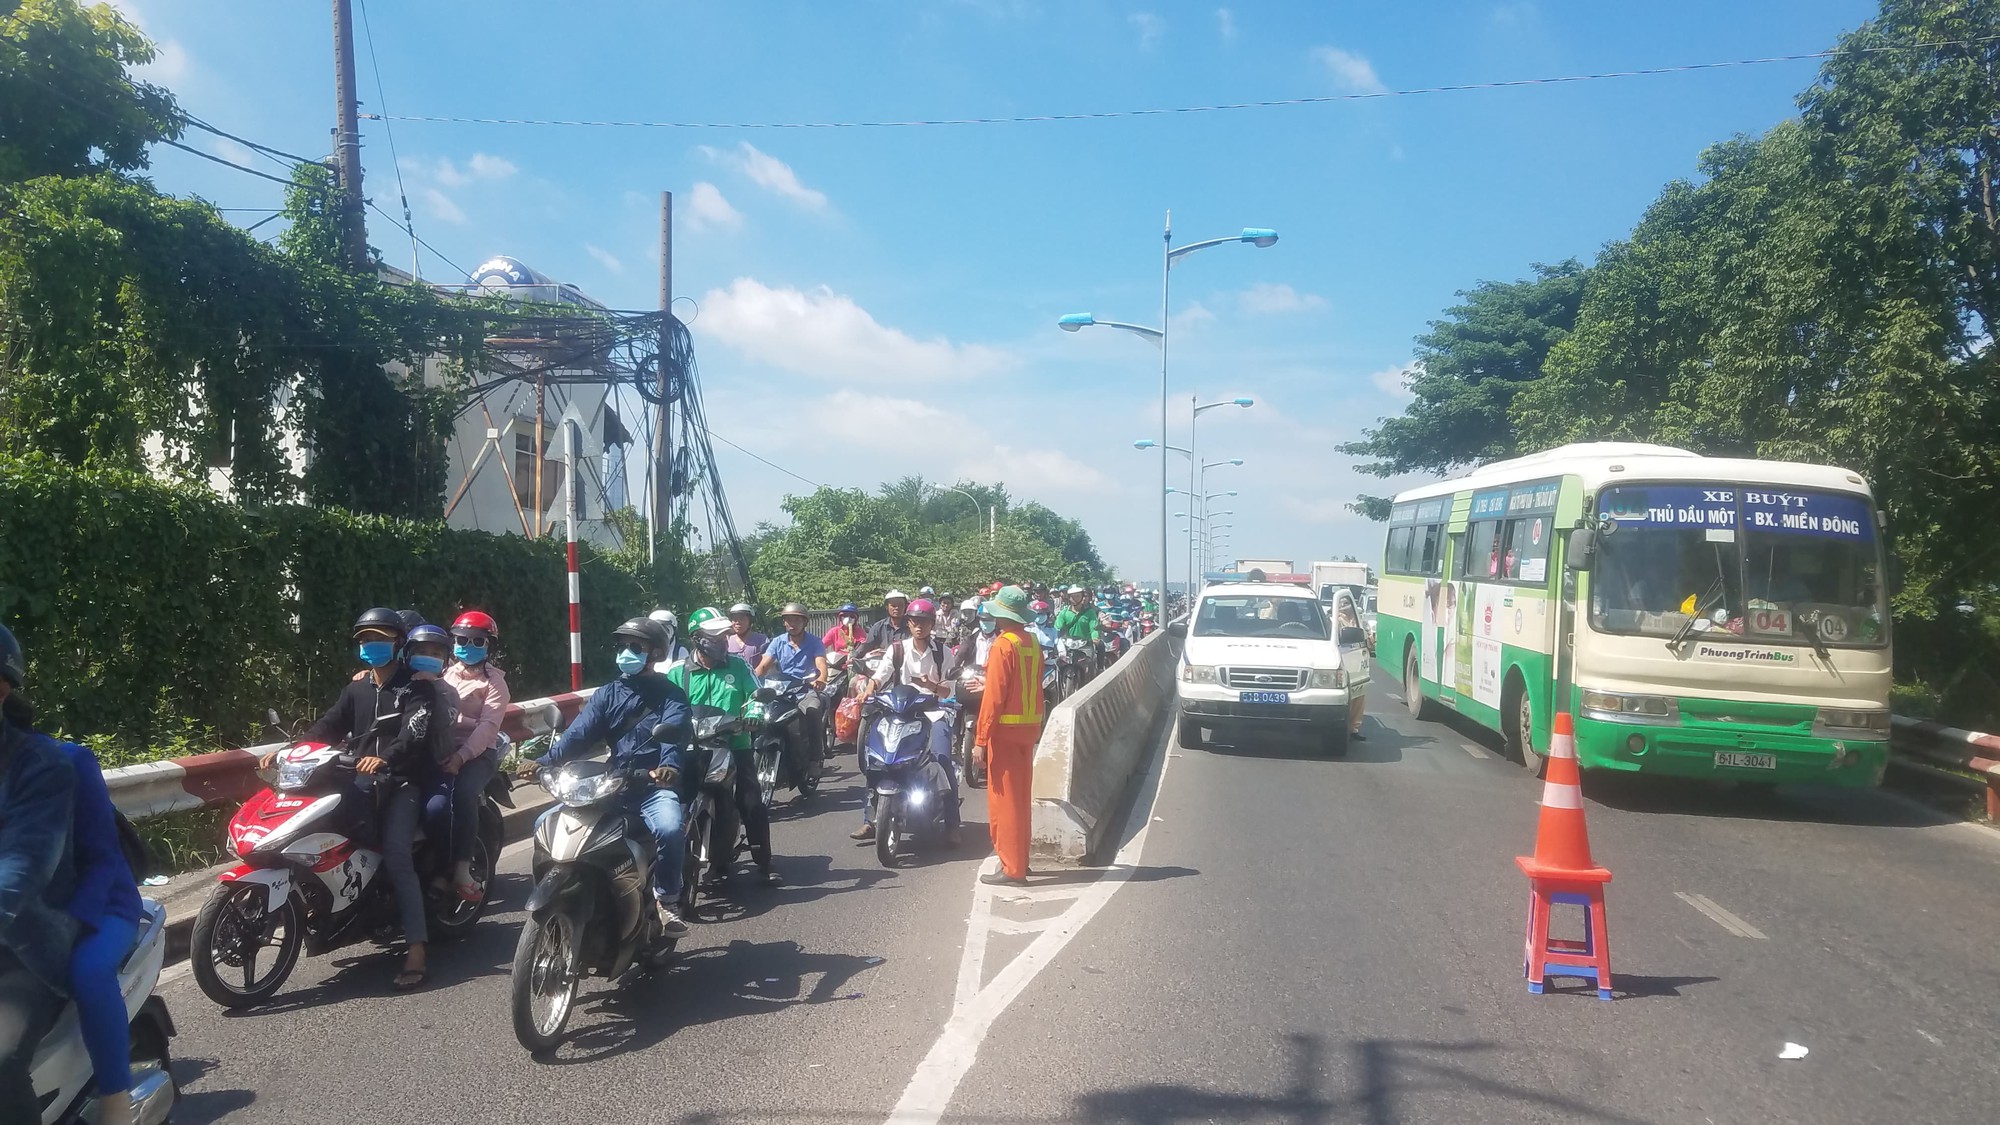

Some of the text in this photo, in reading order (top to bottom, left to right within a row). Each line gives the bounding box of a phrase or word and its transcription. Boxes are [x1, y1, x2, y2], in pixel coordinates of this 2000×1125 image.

[1703, 491, 1808, 508] XE BUÝT
[1649, 504, 1674, 523] THỦ
[1678, 505, 1705, 524] DẦU
[1708, 507, 1736, 527] MỘT
[1755, 512, 1779, 527] BX.
[1783, 512, 1819, 530] MIỀN
[1822, 515, 1860, 535] ĐÔNG
[1756, 612, 1787, 632] 04
[1824, 618, 1844, 636] 04
[1700, 647, 1794, 662] PhuongTrinhBus
[1719, 754, 1772, 767] 61L-3041
[275, 800, 304, 808] 150
[613, 858, 632, 875] YAMAHA
